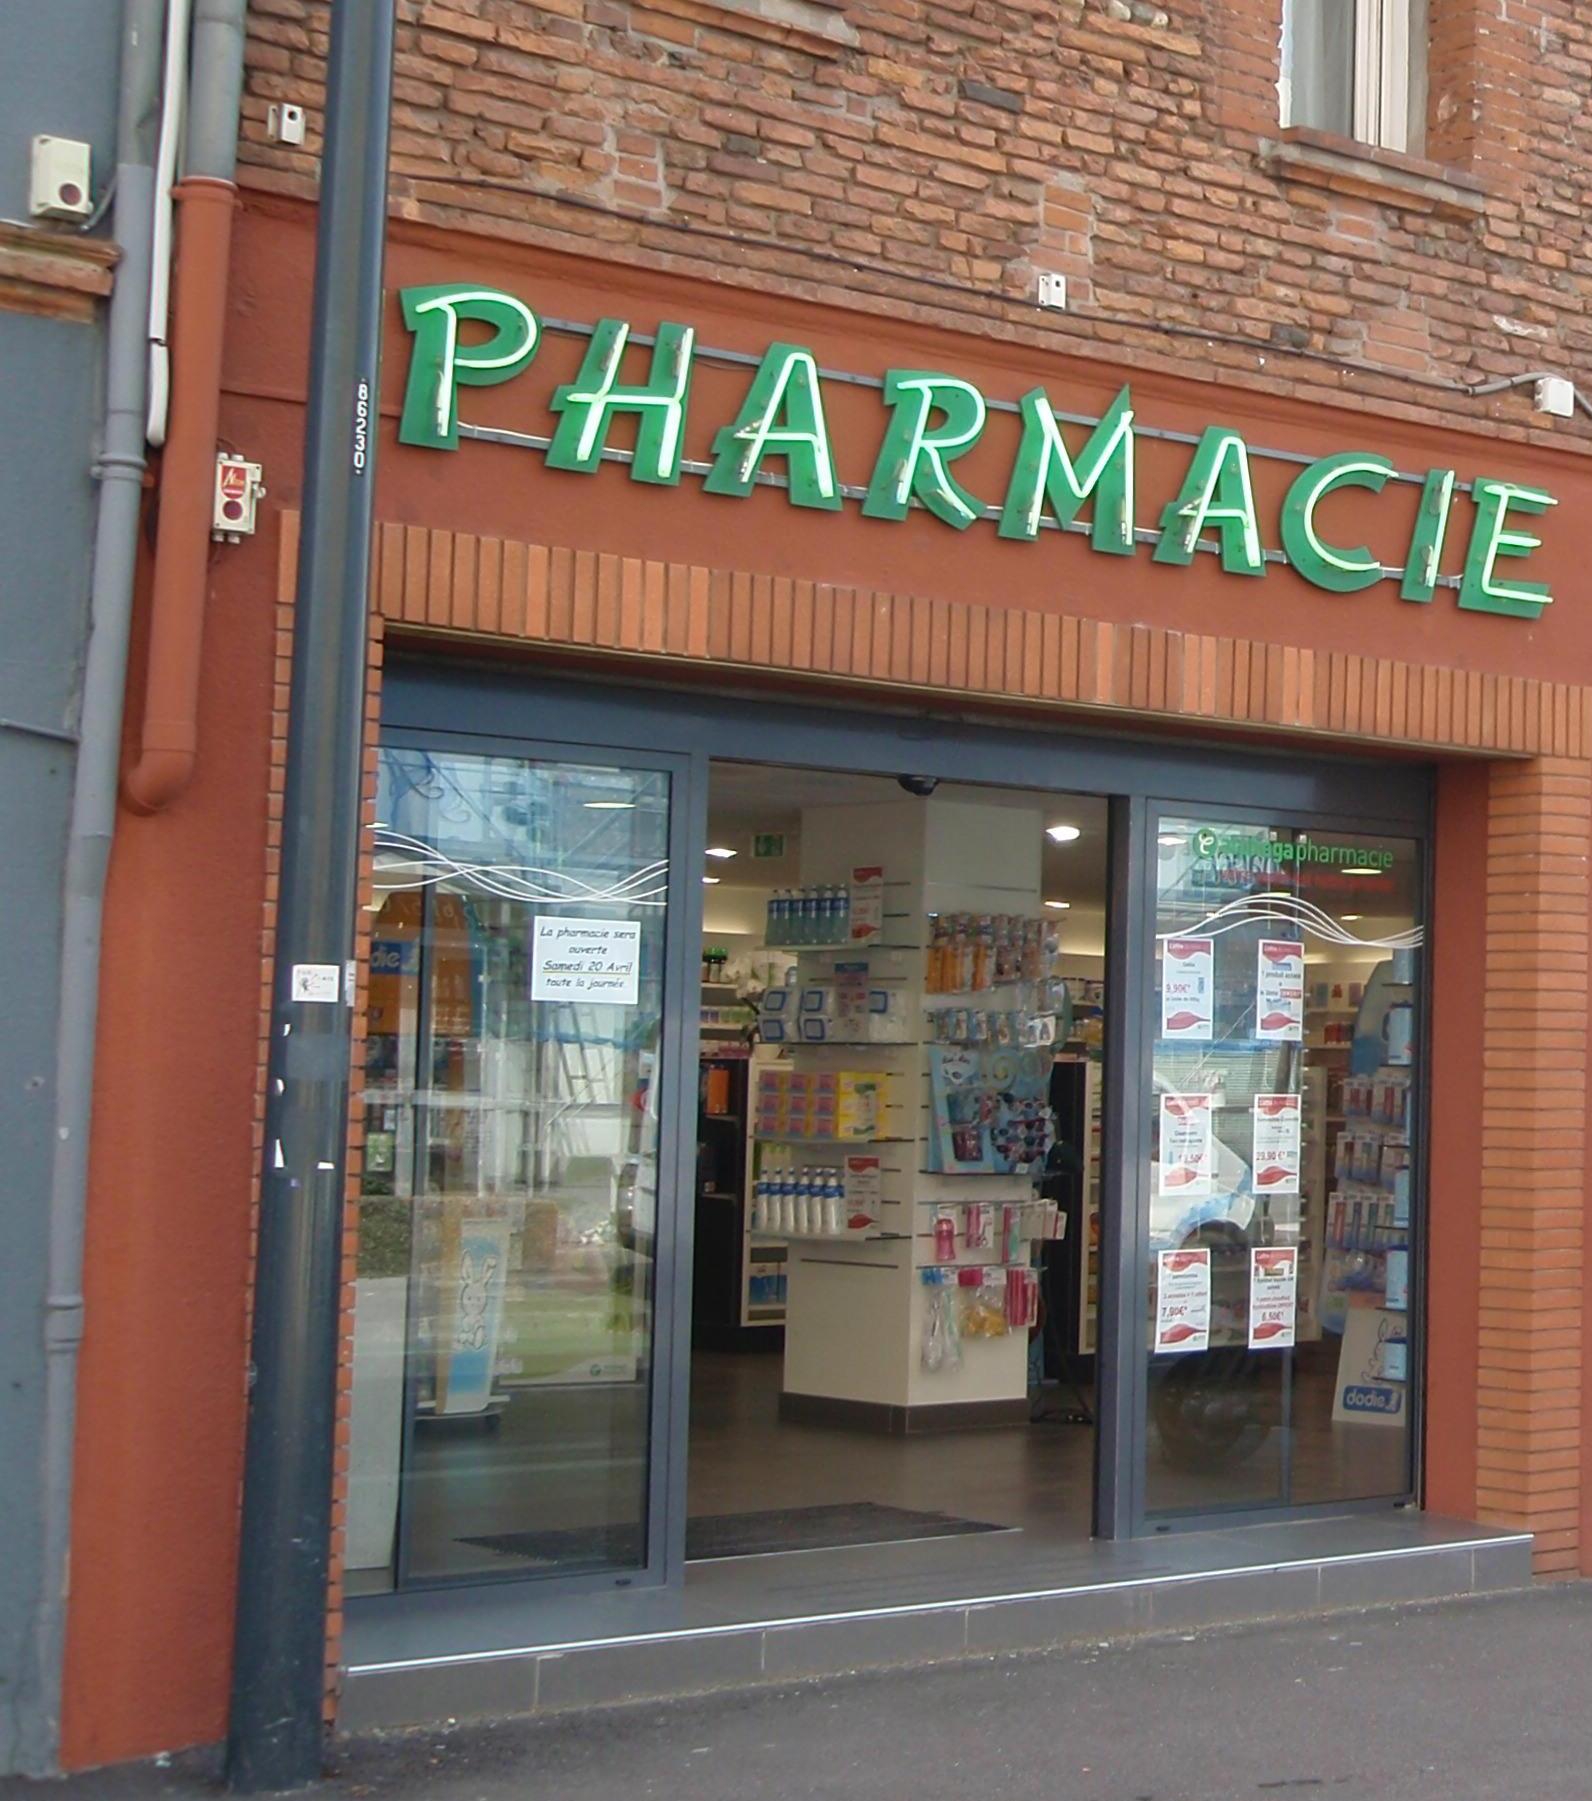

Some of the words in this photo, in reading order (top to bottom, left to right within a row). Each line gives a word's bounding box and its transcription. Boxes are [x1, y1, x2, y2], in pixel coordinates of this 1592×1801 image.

[399, 283, 1558, 618] PHARMACIE
[540, 926, 553, 937] La
[556, 926, 610, 939] pharmacie
[613, 931, 637, 940] sera
[568, 946, 608, 955] ouverte
[543, 960, 583, 971] Samedi
[588, 961, 603, 971] 20
[606, 962, 633, 973] Avril
[546, 978, 572, 987] toute
[1346, 1388, 1386, 1408] dodie
